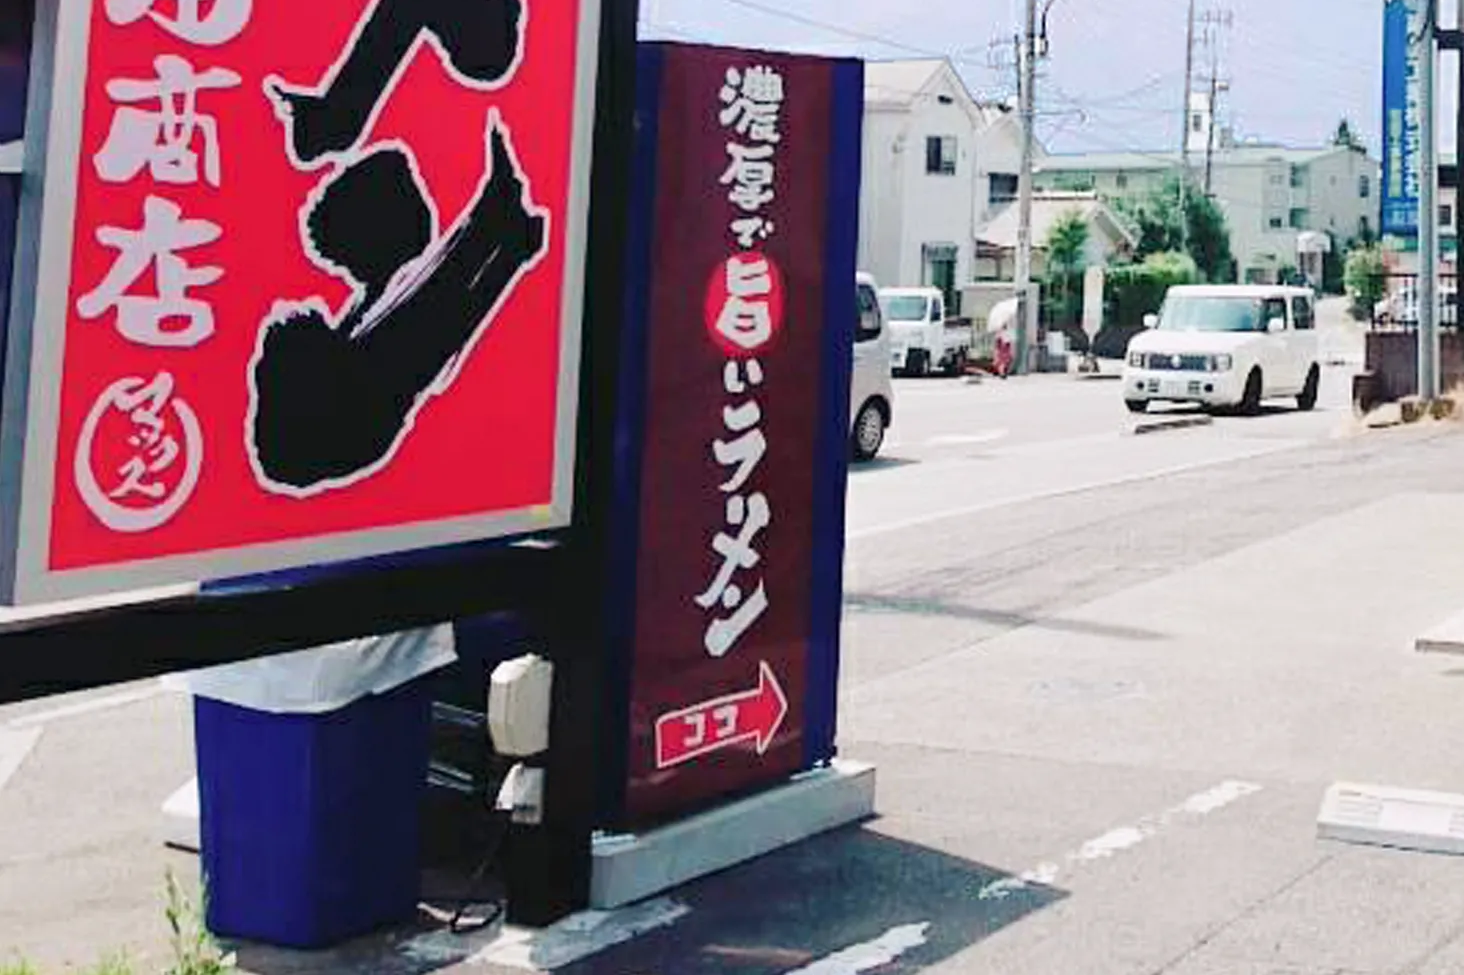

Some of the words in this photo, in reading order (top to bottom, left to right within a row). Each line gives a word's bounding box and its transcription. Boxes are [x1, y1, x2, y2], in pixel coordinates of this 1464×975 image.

[693, 64, 785, 657] 濃厚で旨いラーメン
[683, 703, 739, 747] ココ
